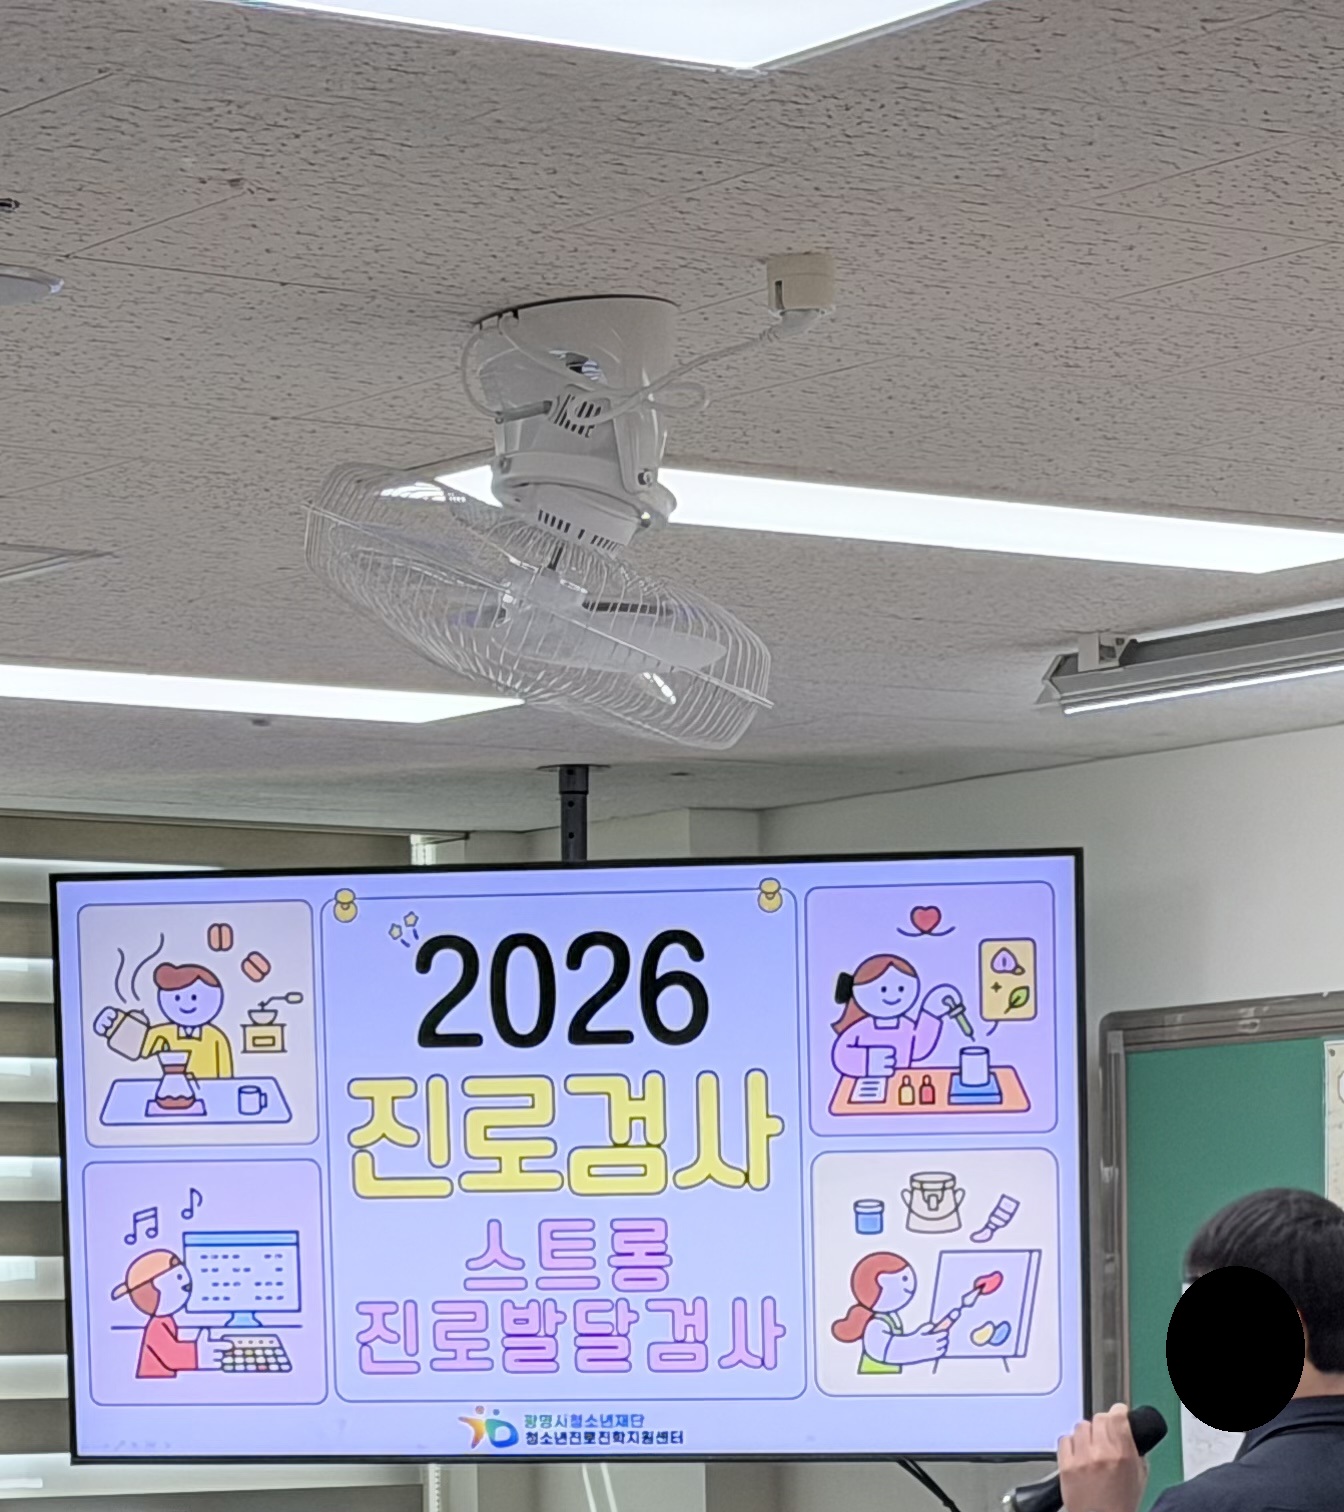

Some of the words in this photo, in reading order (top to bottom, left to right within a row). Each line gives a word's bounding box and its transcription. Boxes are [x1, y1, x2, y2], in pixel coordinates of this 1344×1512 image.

[415, 929, 708, 1050] 2026
[347, 1068, 785, 1199] 진로검사
[463, 1218, 673, 1292] 스트롱
[356, 1297, 787, 1375] 진로발달검사
[523, 1413, 646, 1429] 광명시청소년재단
[525, 1430, 685, 1446] 청소년진로진학지원센터
